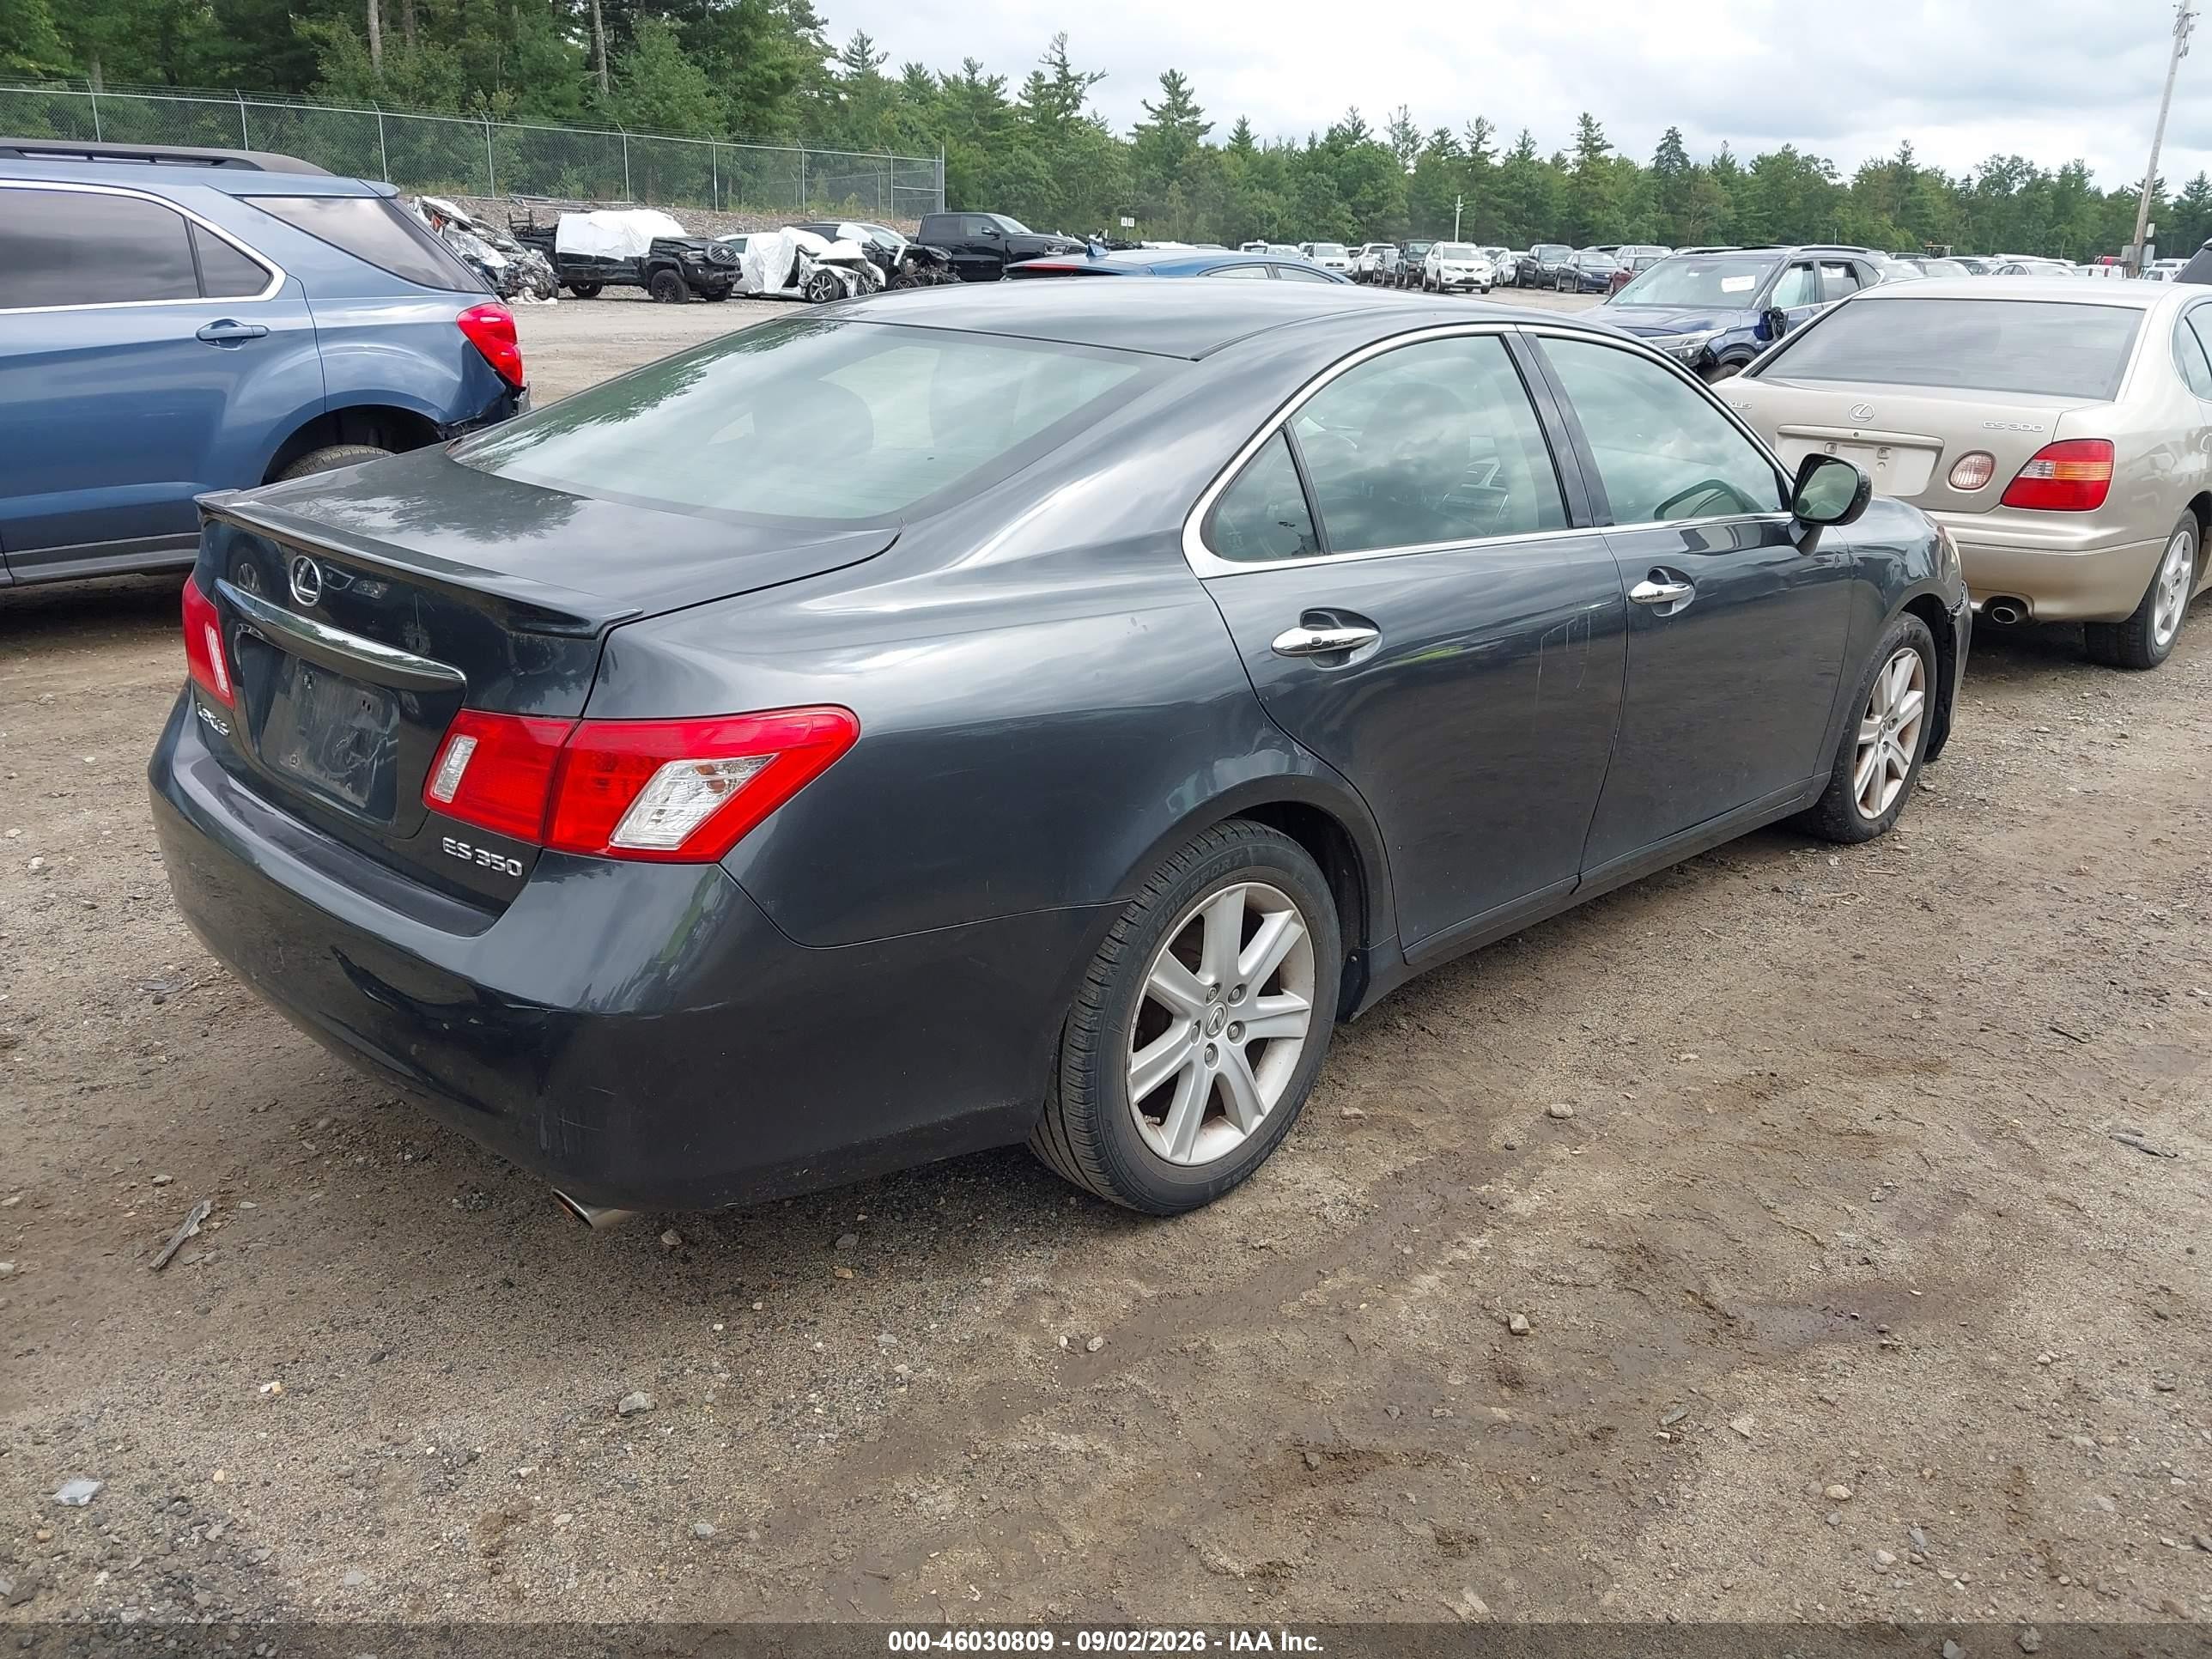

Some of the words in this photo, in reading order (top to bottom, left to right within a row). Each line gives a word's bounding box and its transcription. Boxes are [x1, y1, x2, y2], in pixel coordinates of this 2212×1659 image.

[1983, 421, 2006, 430] GS
[2008, 422, 2045, 432] 300
[442, 836, 472, 860] ES
[475, 848, 523, 877] 350
